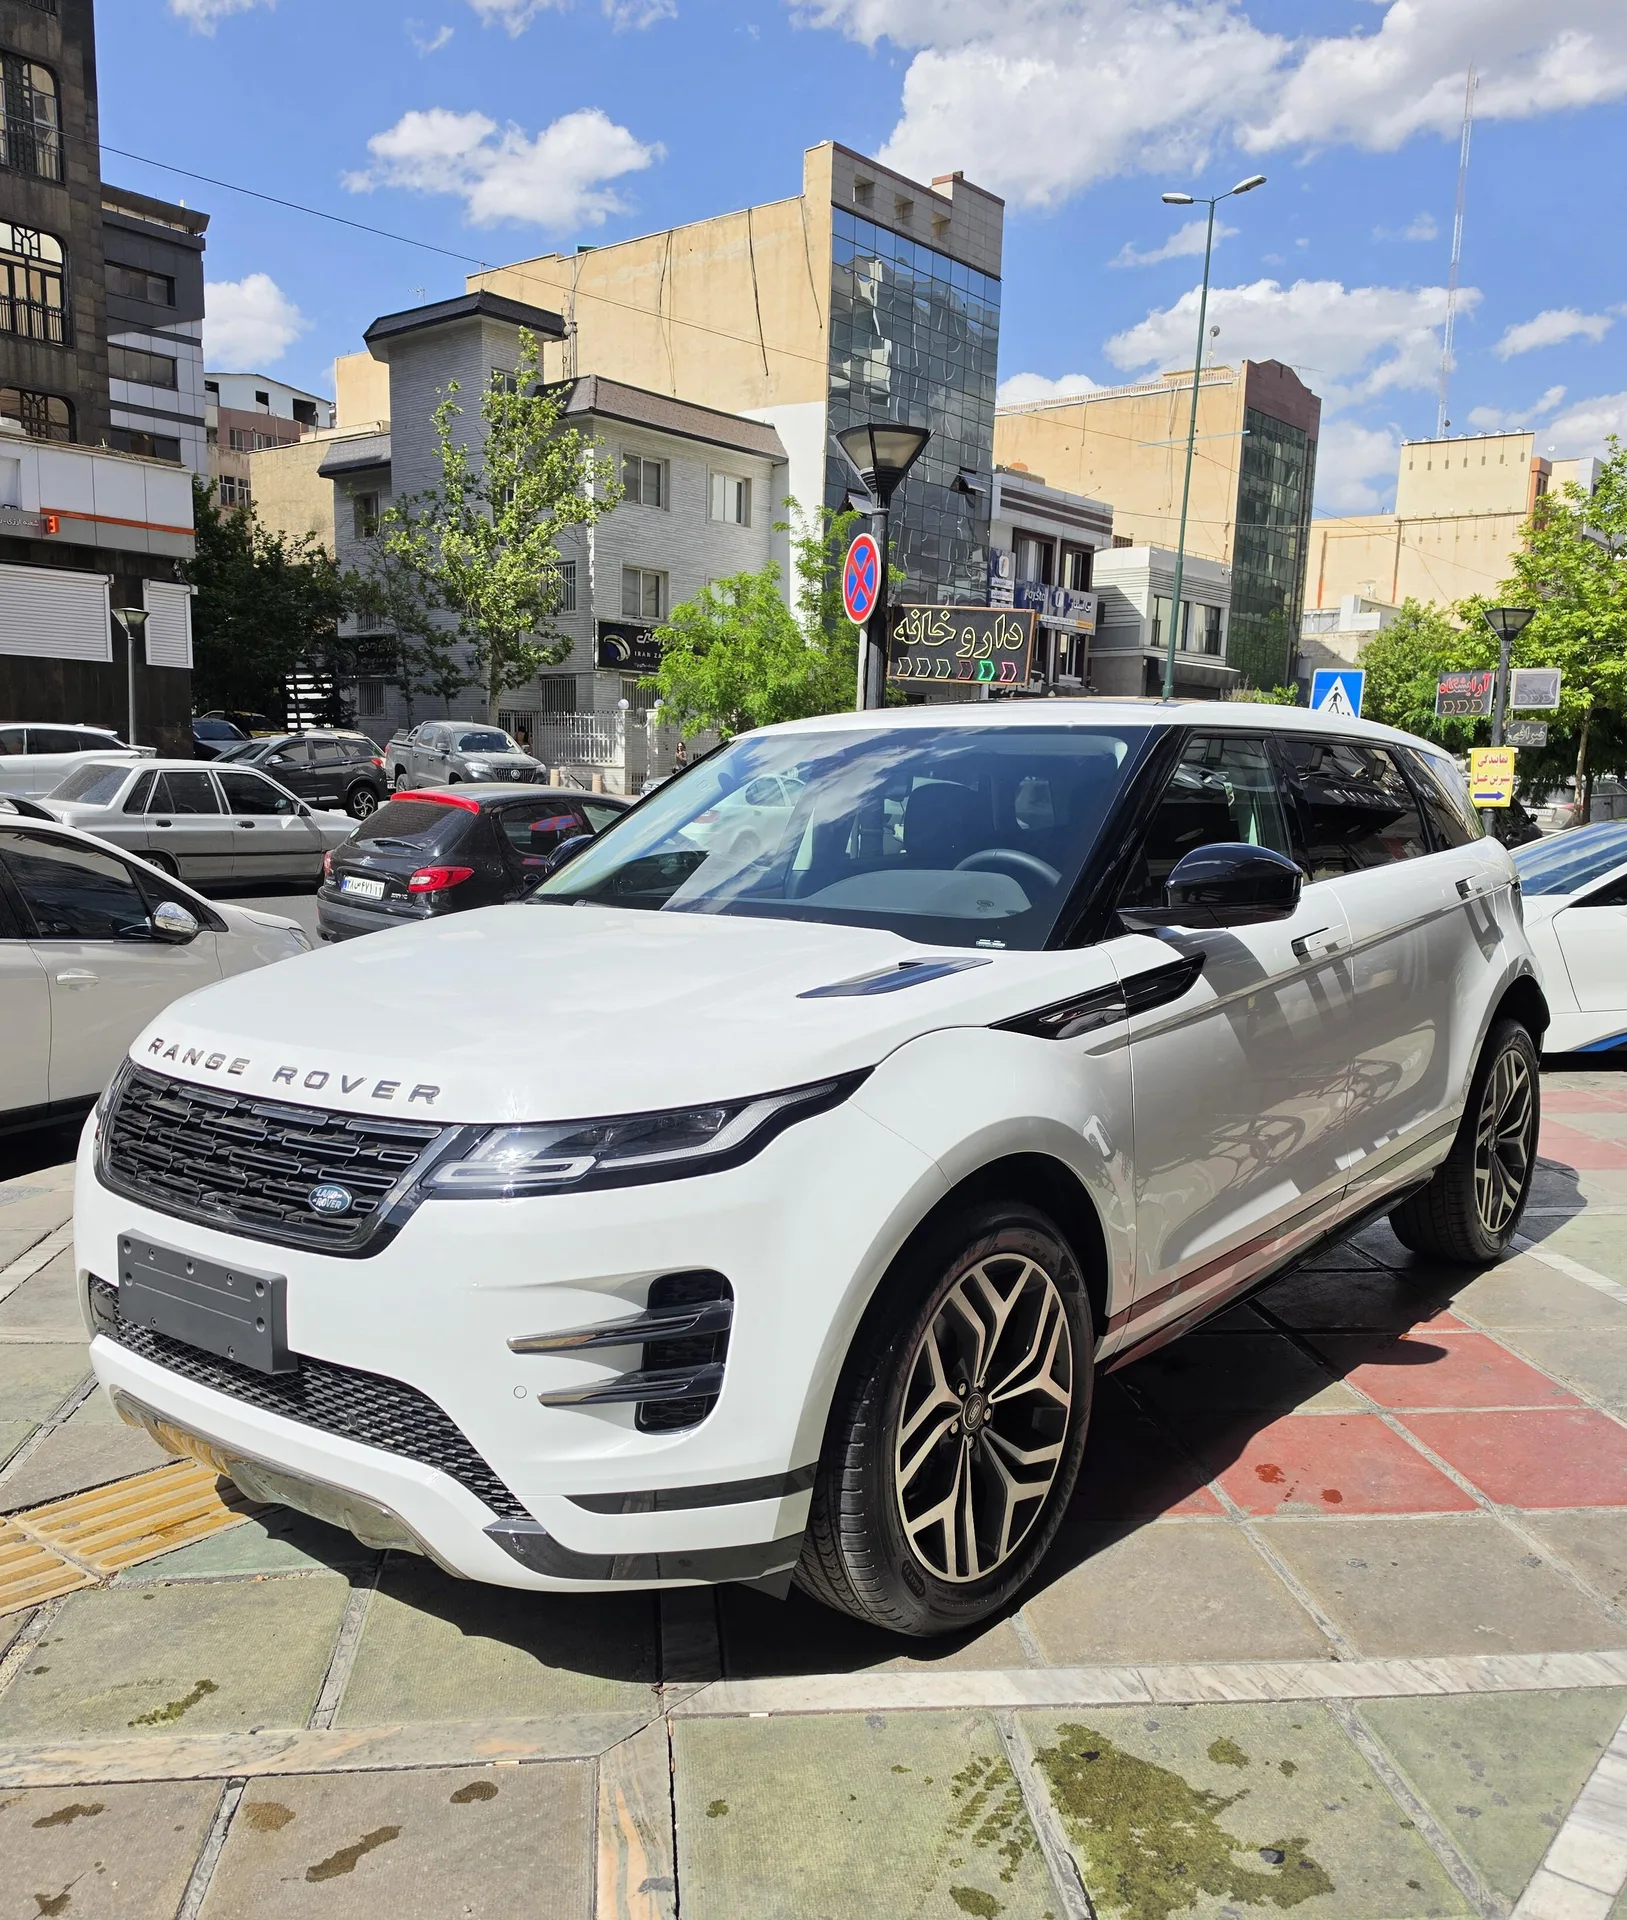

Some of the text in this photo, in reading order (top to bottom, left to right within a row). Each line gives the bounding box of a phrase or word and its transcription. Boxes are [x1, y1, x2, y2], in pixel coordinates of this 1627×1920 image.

[634, 650, 651, 658] IRAN
[1439, 673, 1492, 697] آرایشگاه
[1473, 772, 1511, 786] شیرین عسل
[148, 1037, 441, 1105] RANGE ROVER
[315, 1188, 339, 1200] LAND
[315, 1197, 342, 1209] ROVER
